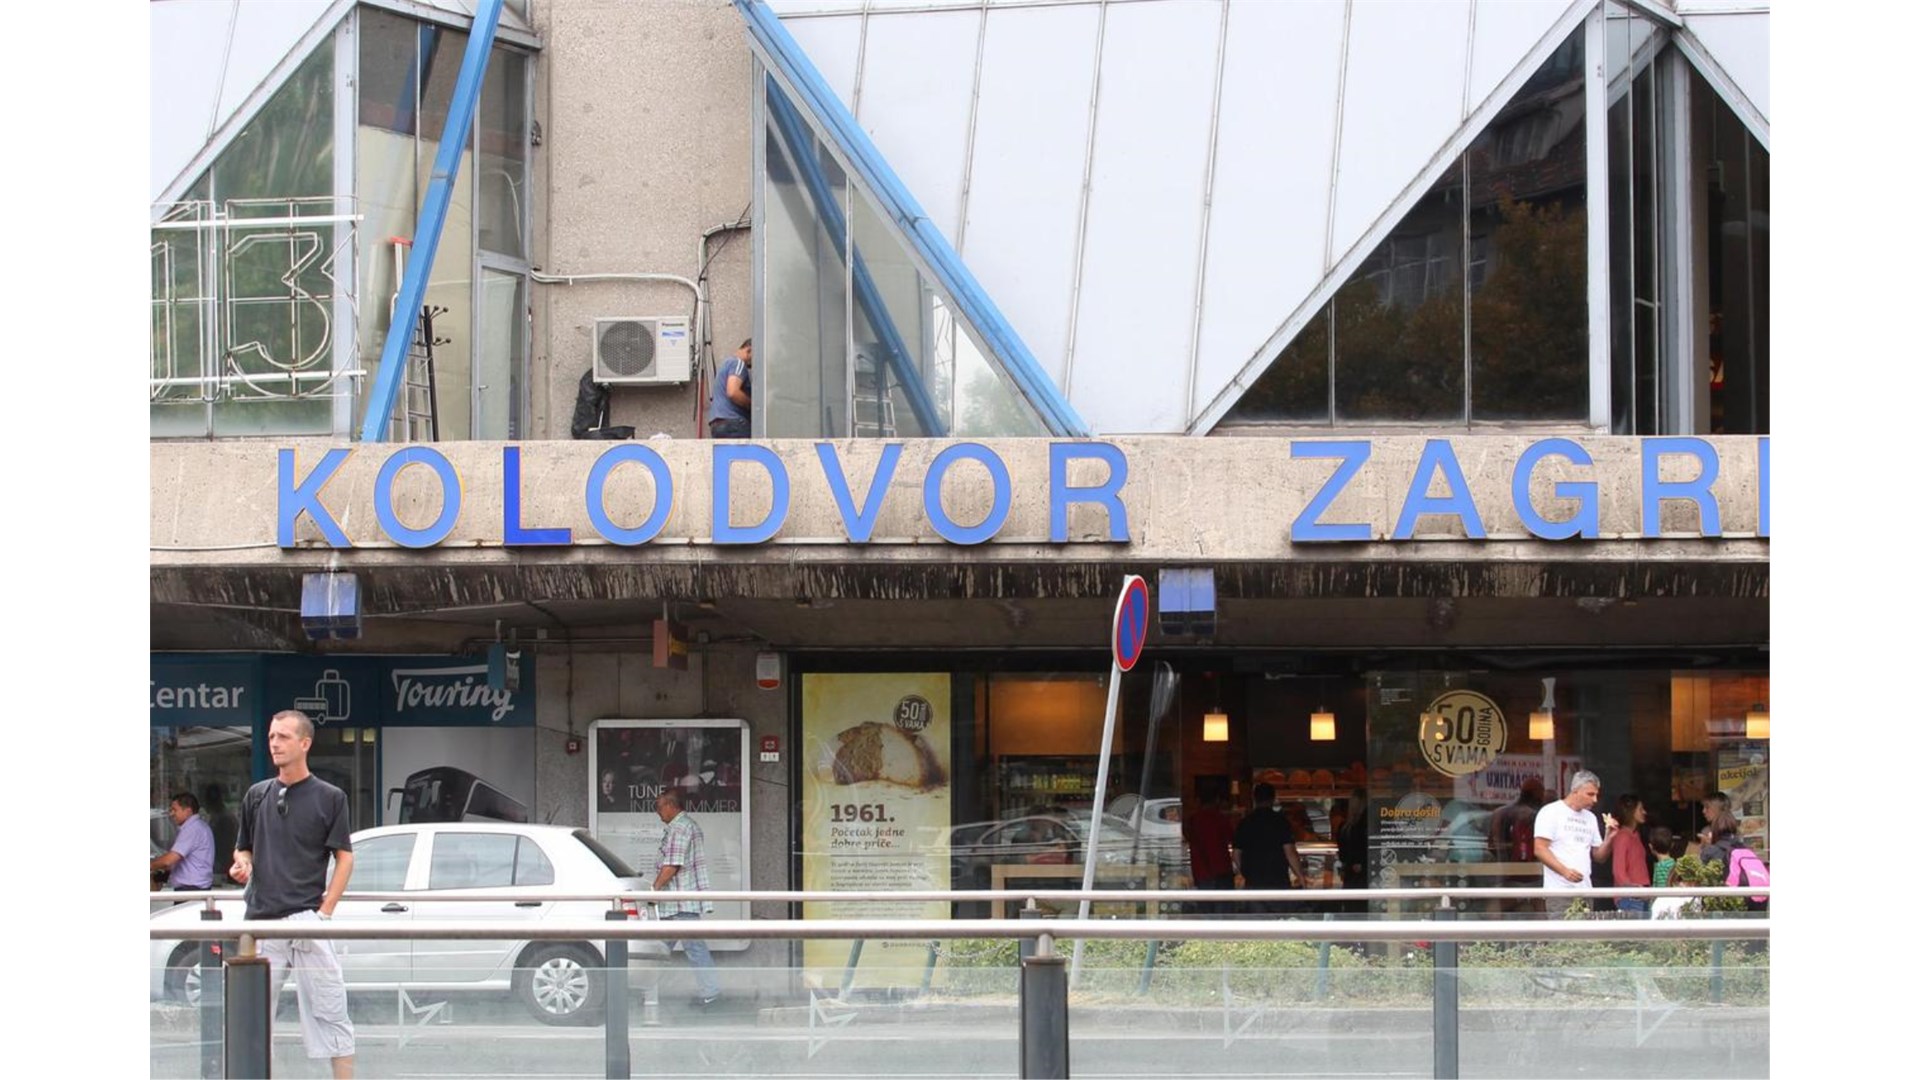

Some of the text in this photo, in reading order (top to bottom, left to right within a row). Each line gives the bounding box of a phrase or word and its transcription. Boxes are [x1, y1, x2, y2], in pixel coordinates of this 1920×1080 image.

[277, 442, 1131, 548] KOLODVOR
[150, 680, 244, 709] entar
[391, 664, 515, 721] Touring
[901, 700, 919, 720] 50
[1437, 704, 1475, 744] 50
[1477, 707, 1493, 746] GODINA
[830, 803, 895, 822] 1961.
[1380, 806, 1411, 818] Dobro
[831, 827, 905, 839] Početak jedne
[831, 839, 861, 850] dobre
